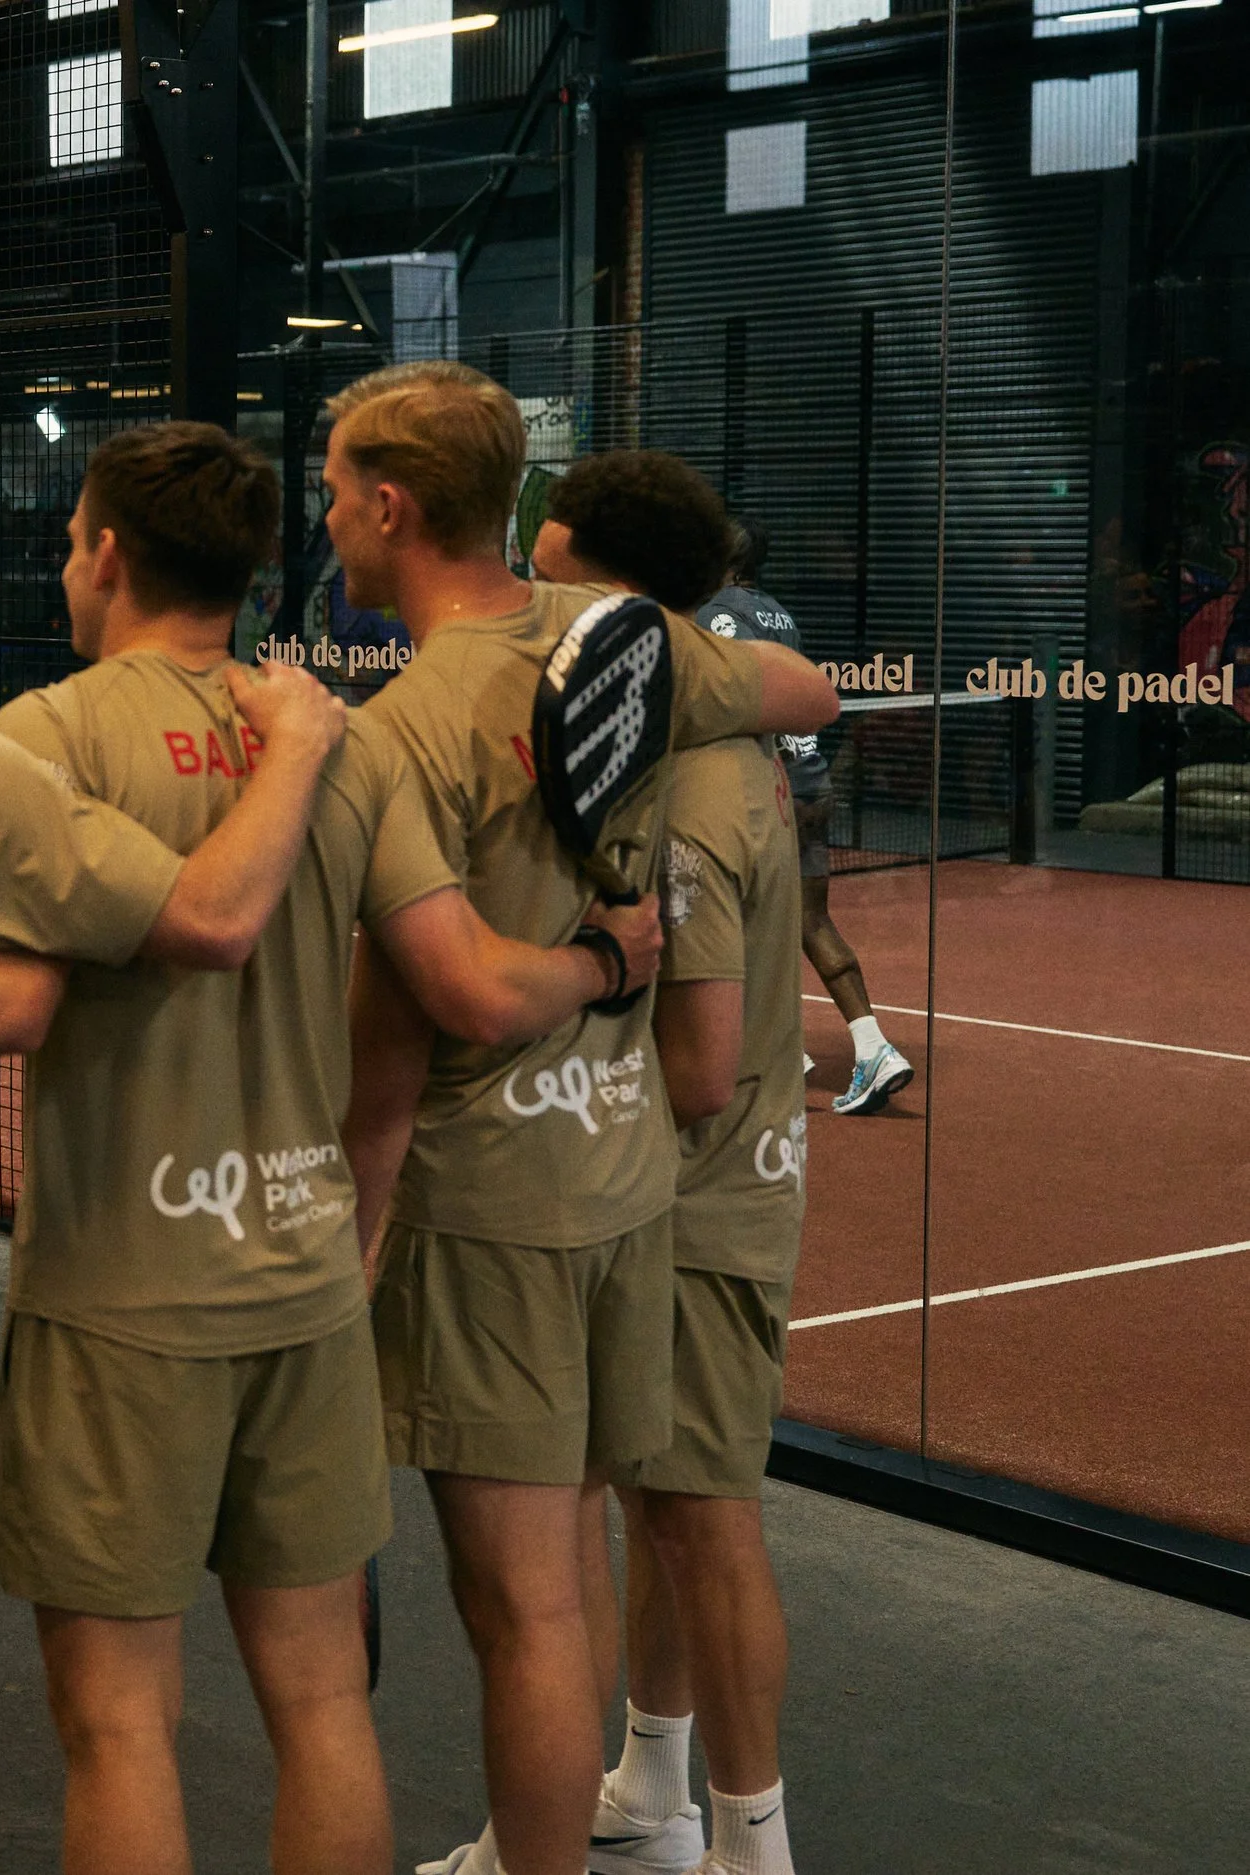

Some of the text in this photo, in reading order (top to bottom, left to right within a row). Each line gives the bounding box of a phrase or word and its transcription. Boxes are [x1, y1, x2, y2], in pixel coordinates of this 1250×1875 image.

[256, 633, 306, 666] club
[312, 635, 342, 668] de
[966, 657, 1234, 713] club de padel
